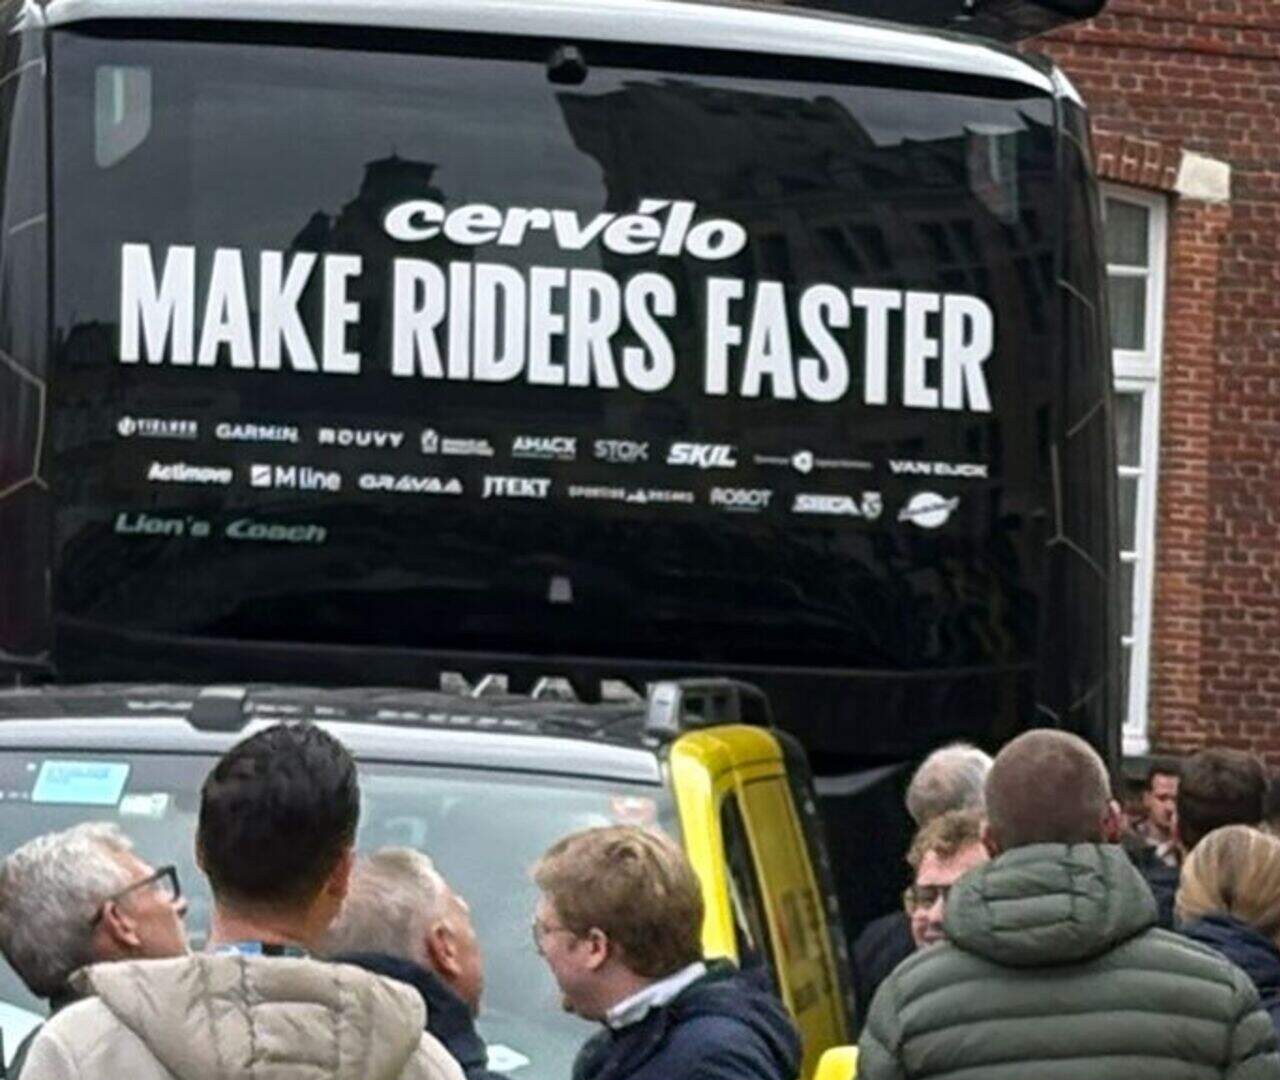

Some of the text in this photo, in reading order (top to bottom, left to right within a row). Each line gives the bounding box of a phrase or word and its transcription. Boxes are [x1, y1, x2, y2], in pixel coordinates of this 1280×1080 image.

[384, 198, 747, 260] cervélo
[120, 242, 995, 413] MAKE RIDERS FASTER
[215, 422, 300, 443] GARMIN
[318, 428, 404, 447] ROUVY
[666, 442, 737, 468] SKIL
[889, 459, 931, 475] VAN
[482, 476, 551, 498] JTEKT
